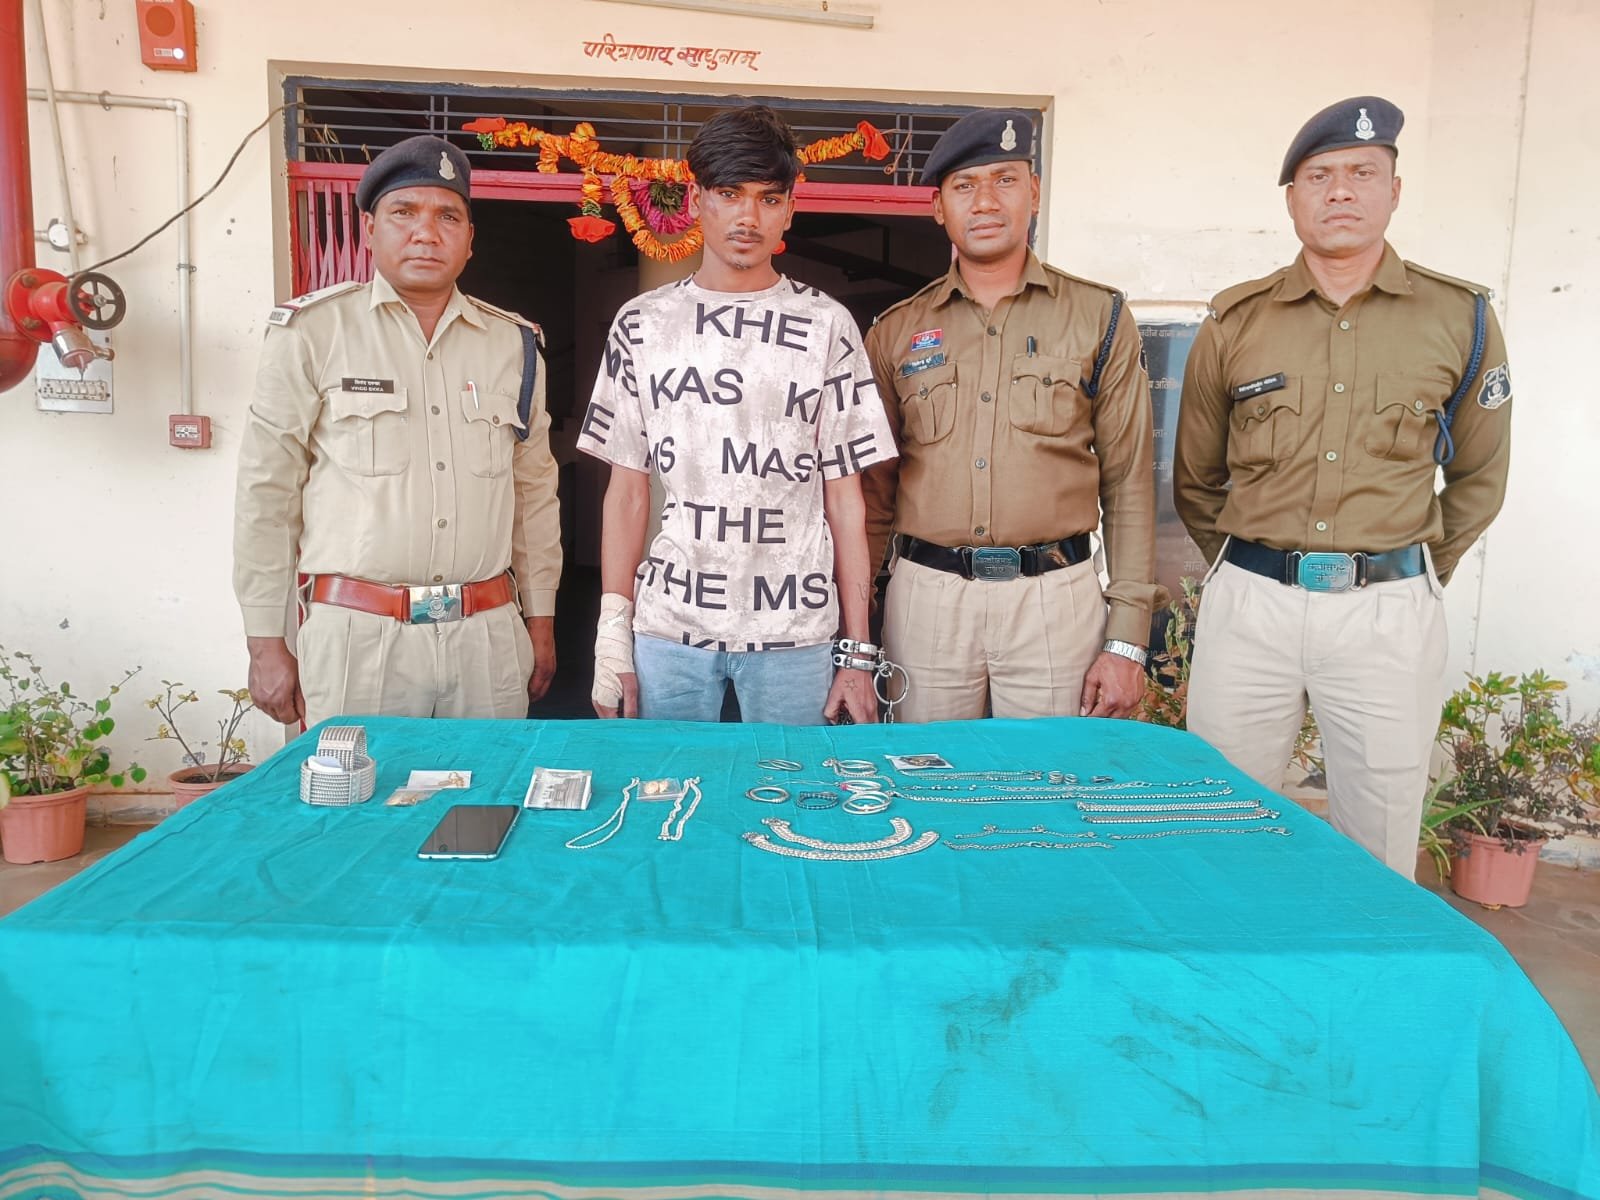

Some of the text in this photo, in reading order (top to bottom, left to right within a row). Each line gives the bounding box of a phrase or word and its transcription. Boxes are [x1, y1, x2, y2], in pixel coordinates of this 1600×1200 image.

[695, 302, 812, 352] KHE
[650, 366, 744, 410] KAS
[721, 437, 817, 482] MAS
[683, 501, 786, 544] THE
[647, 556, 829, 611] THE MS
